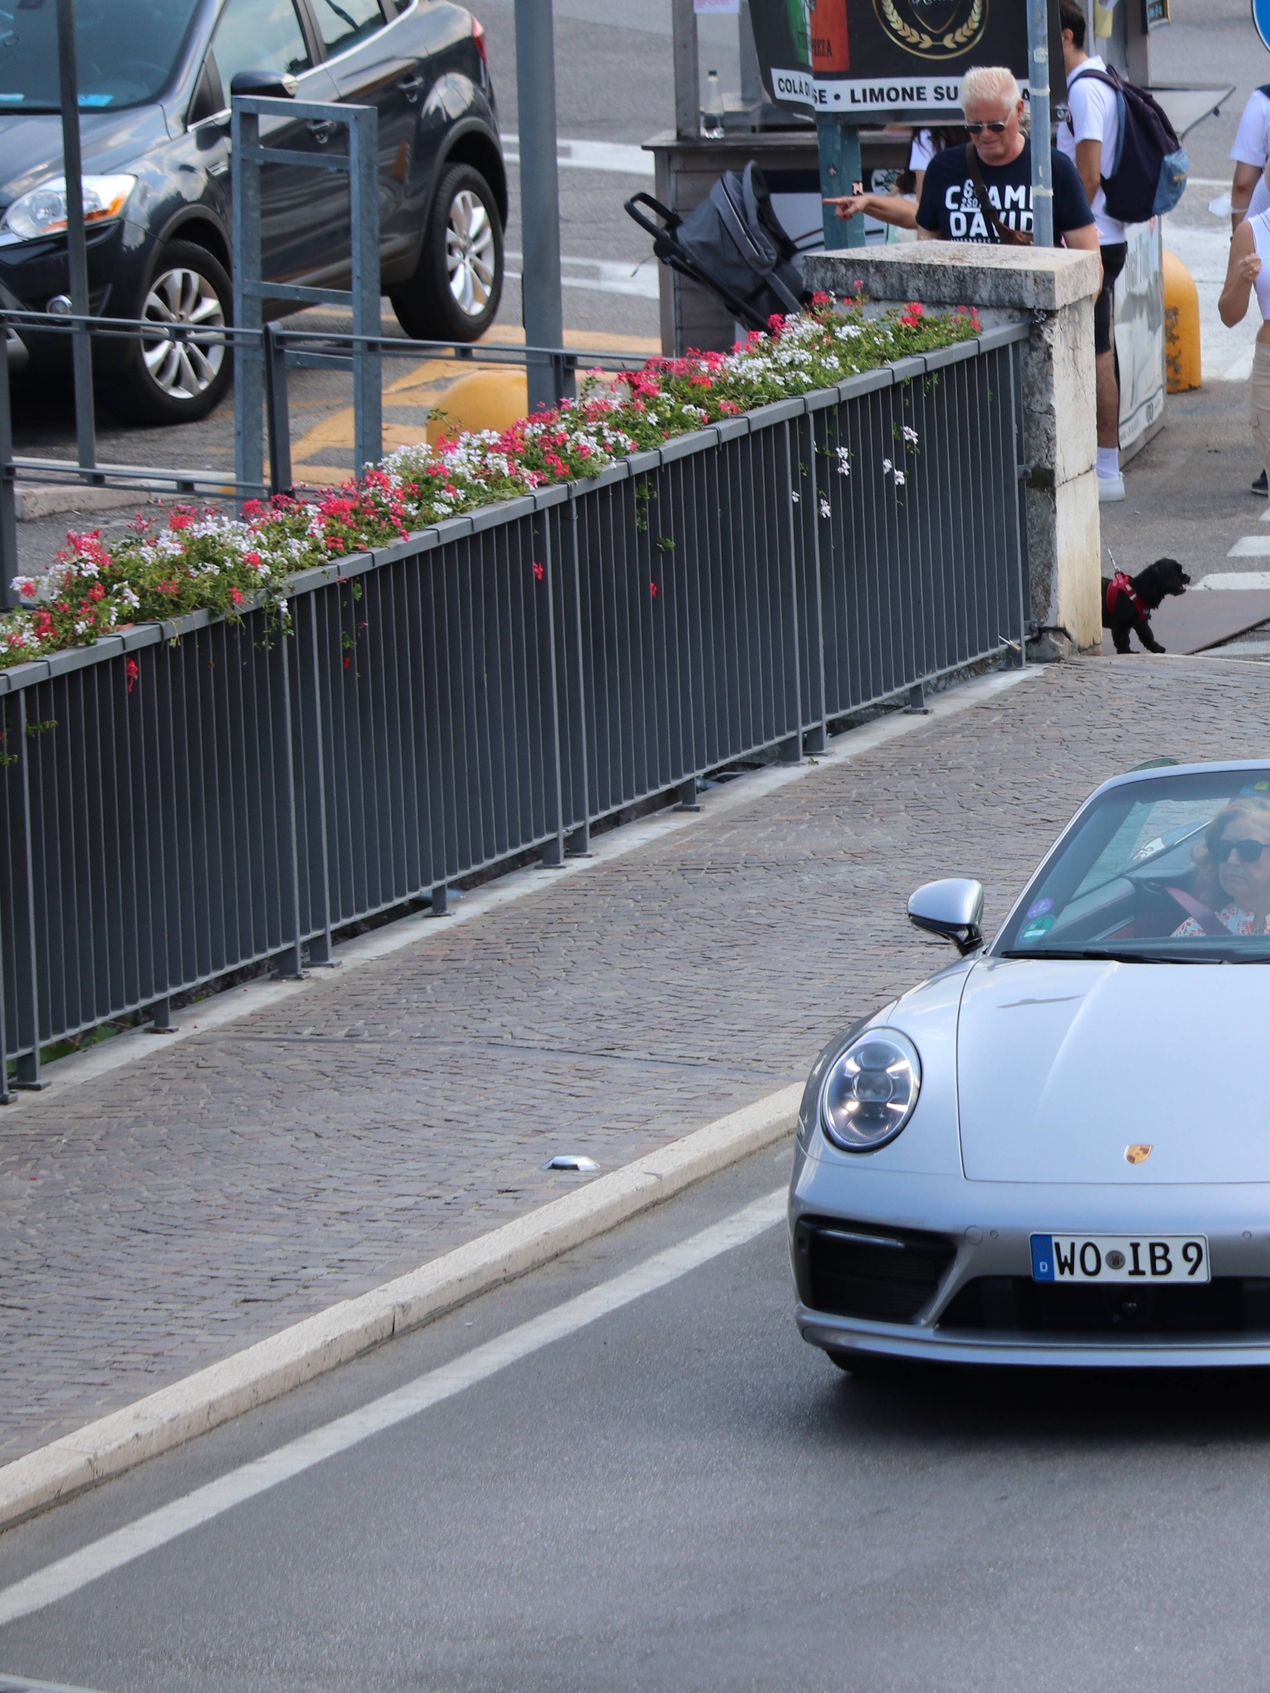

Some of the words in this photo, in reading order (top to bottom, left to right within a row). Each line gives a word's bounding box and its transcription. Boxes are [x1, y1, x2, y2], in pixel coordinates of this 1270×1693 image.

[850, 86, 927, 104] LIMONE
[1039, 1261, 1049, 1273] D
[1054, 1241, 1102, 1276] WO
